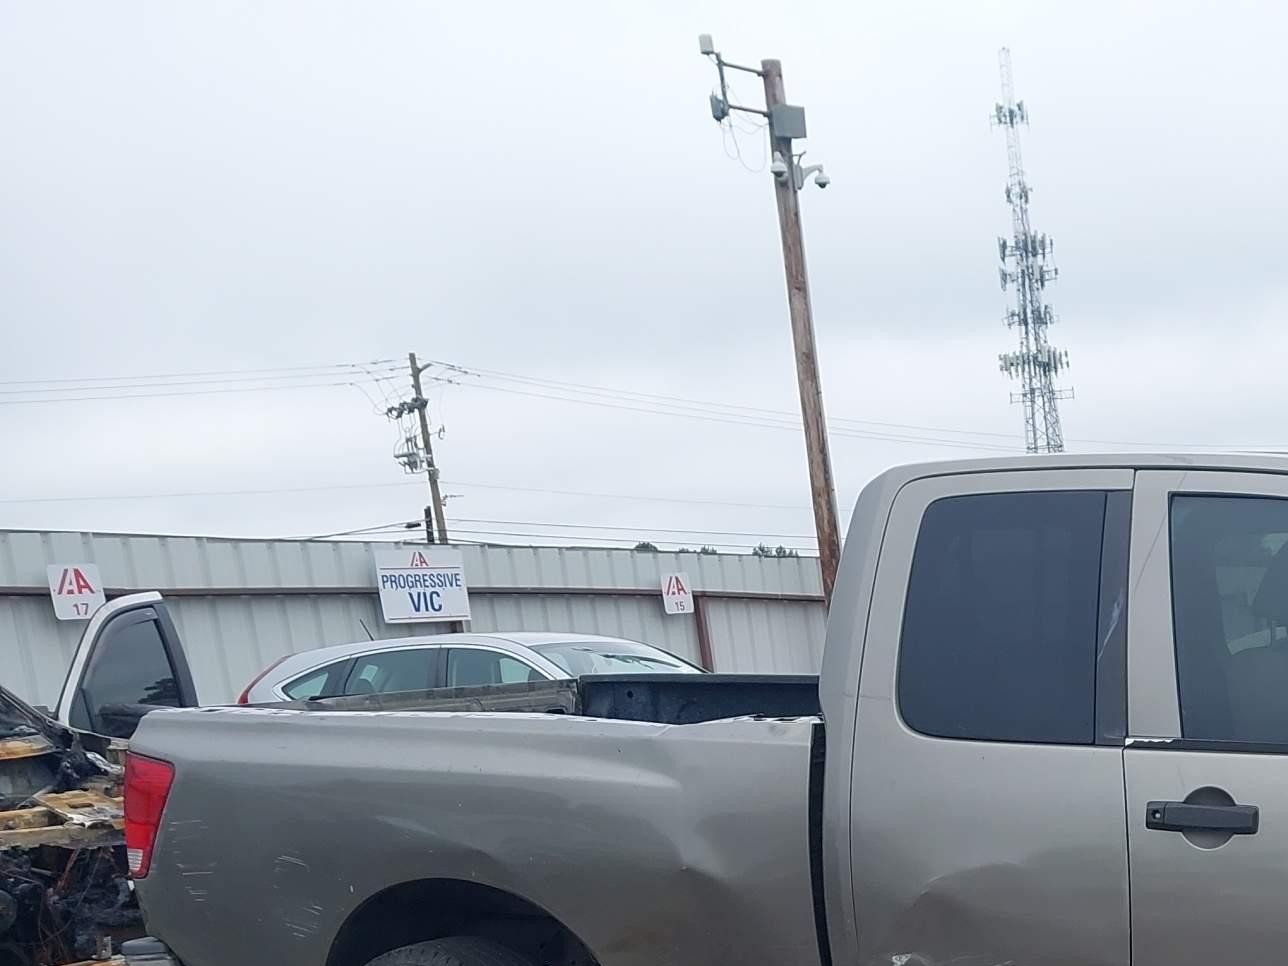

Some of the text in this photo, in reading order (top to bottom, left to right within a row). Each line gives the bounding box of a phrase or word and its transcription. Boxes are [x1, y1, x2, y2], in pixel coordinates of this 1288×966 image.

[380, 573, 463, 591] PROGRESSIVE
[72, 602, 89, 616] 17
[407, 590, 443, 613] VIC
[674, 600, 686, 612] 15
